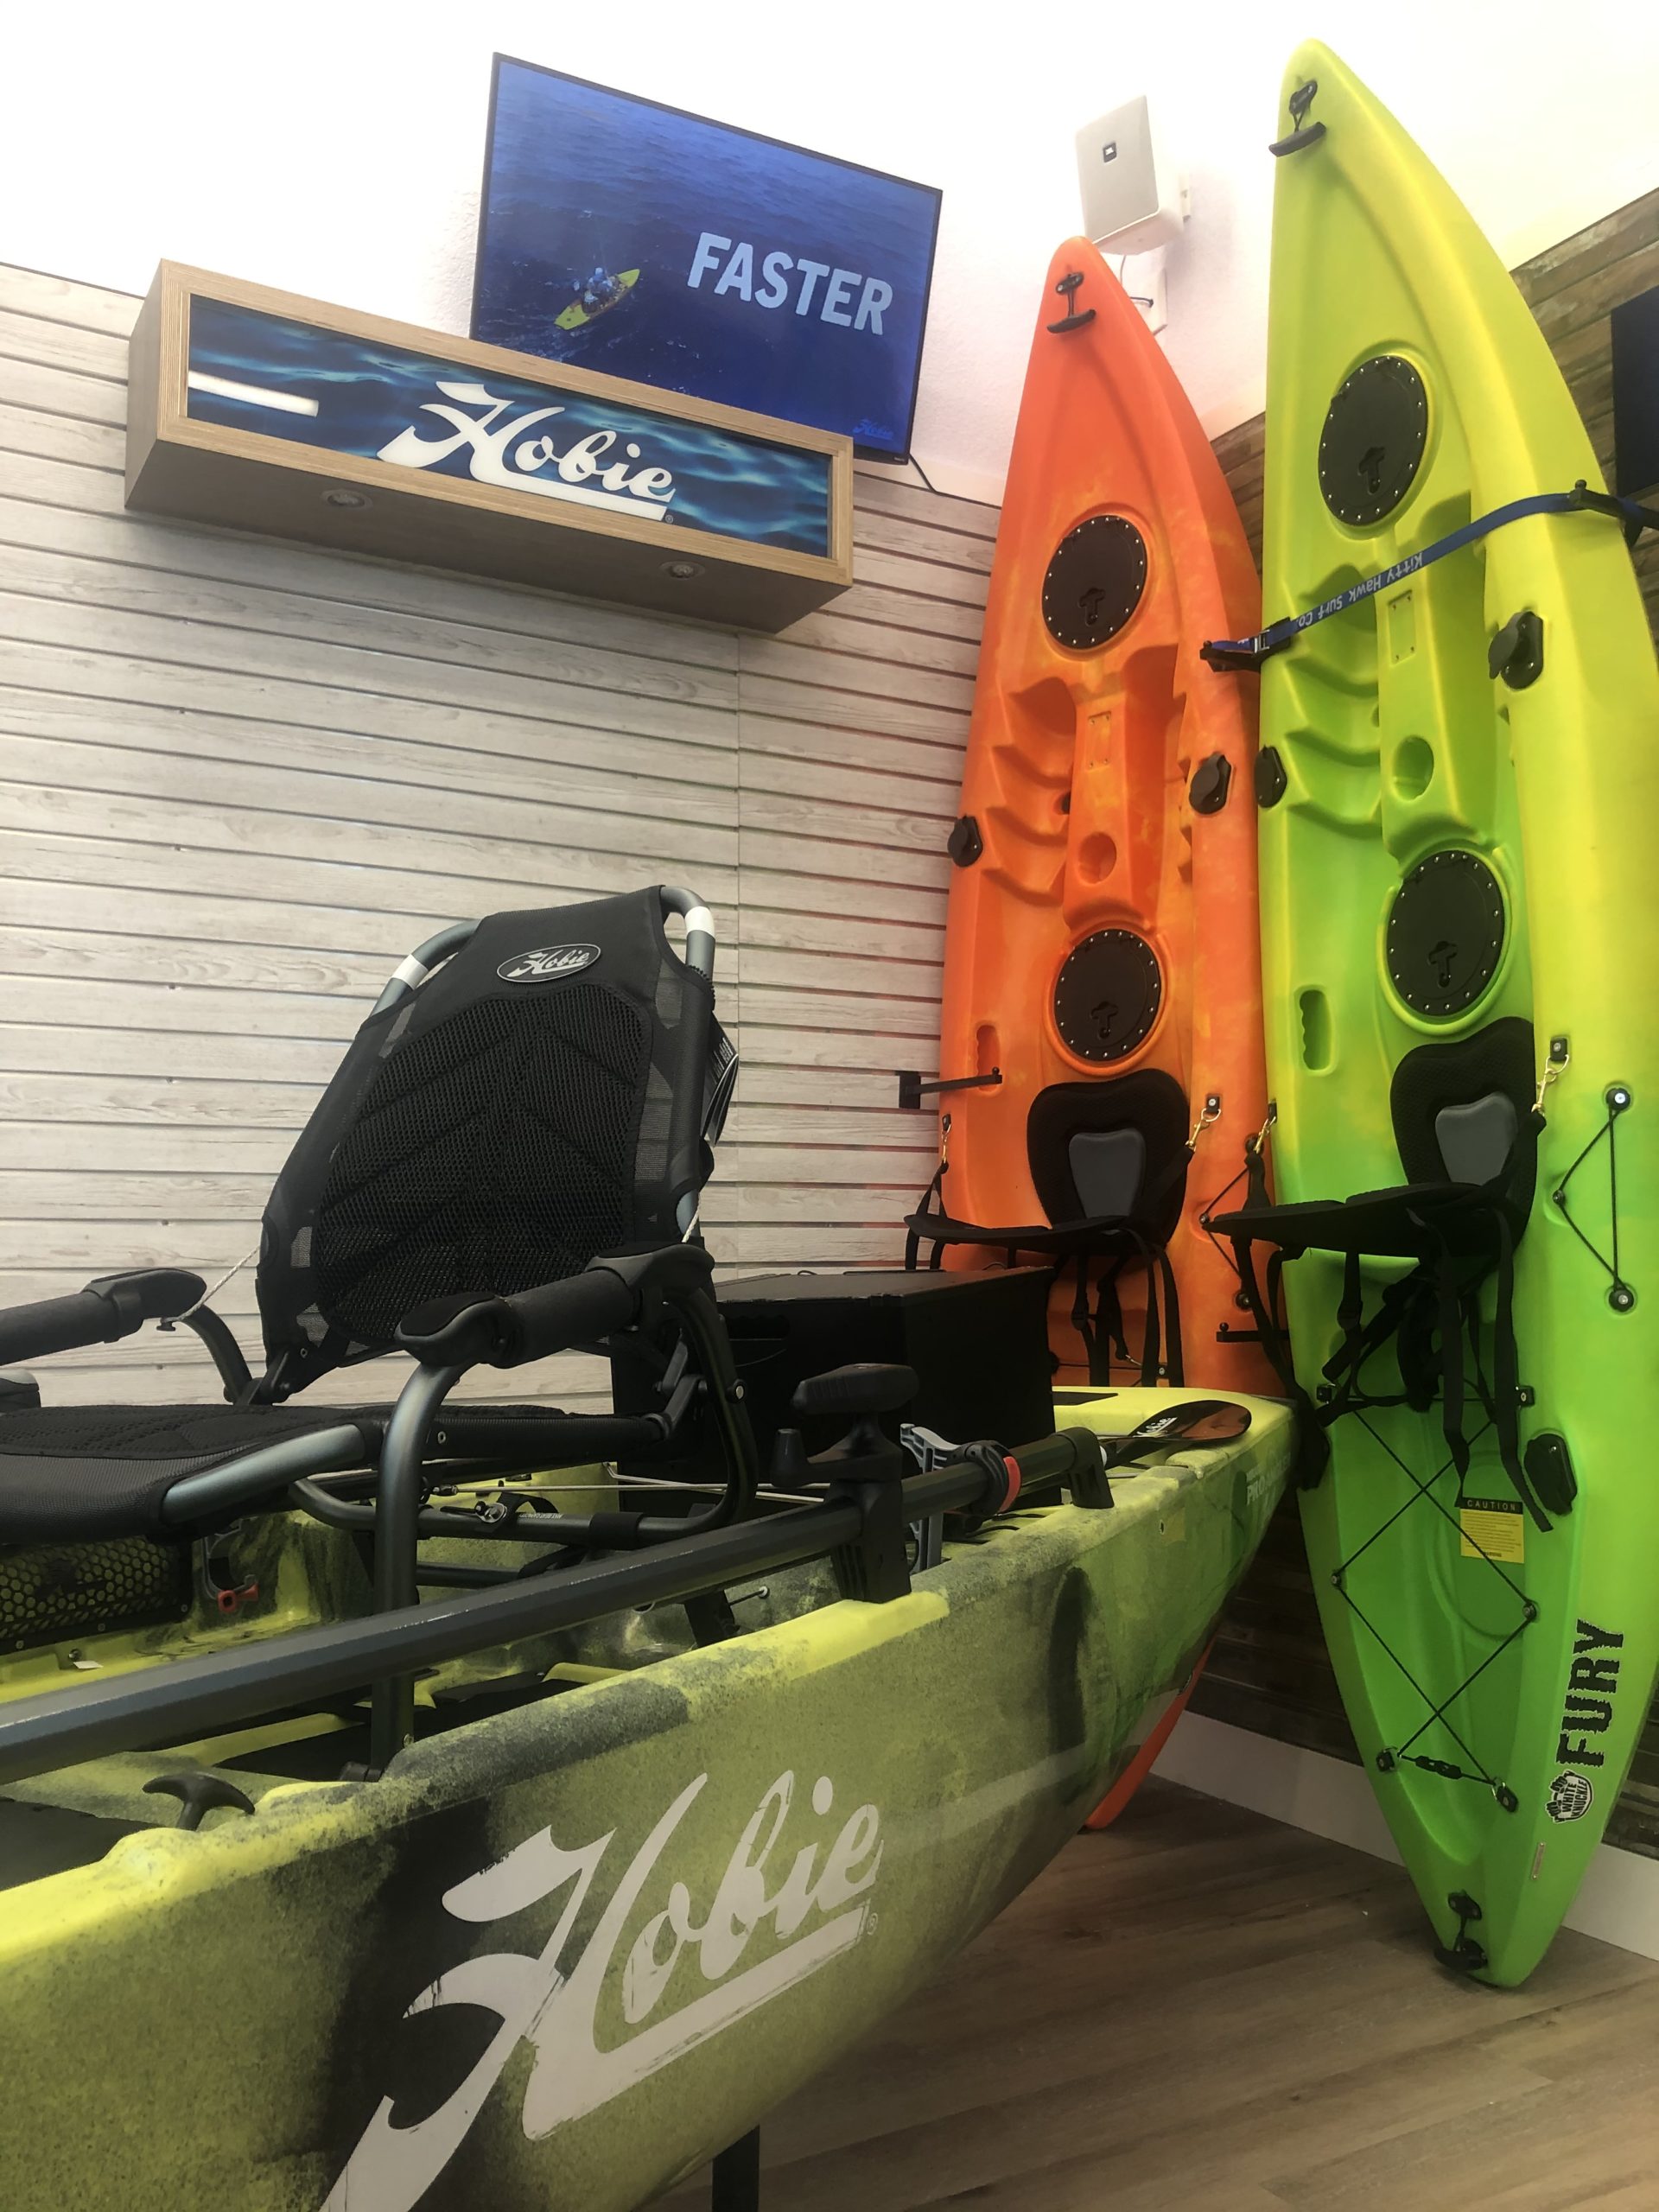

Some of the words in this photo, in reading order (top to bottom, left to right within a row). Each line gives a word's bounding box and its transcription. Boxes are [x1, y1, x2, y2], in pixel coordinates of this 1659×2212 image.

[688, 232, 893, 335] FASTER
[376, 381, 676, 521] Hobie
[1386, 552, 1422, 583] Kitty
[1349, 576, 1381, 601] Hawk
[1318, 595, 1343, 619] Surf
[506, 949, 590, 977] Hobie
[1467, 1499, 1516, 1511] CAUTION
[1556, 1618, 1624, 1767] FURY
[1561, 1783, 1577, 1813] WHITE
[1571, 1779, 1588, 1817] KNUCKLE
[317, 1770, 885, 2212] Hobie
